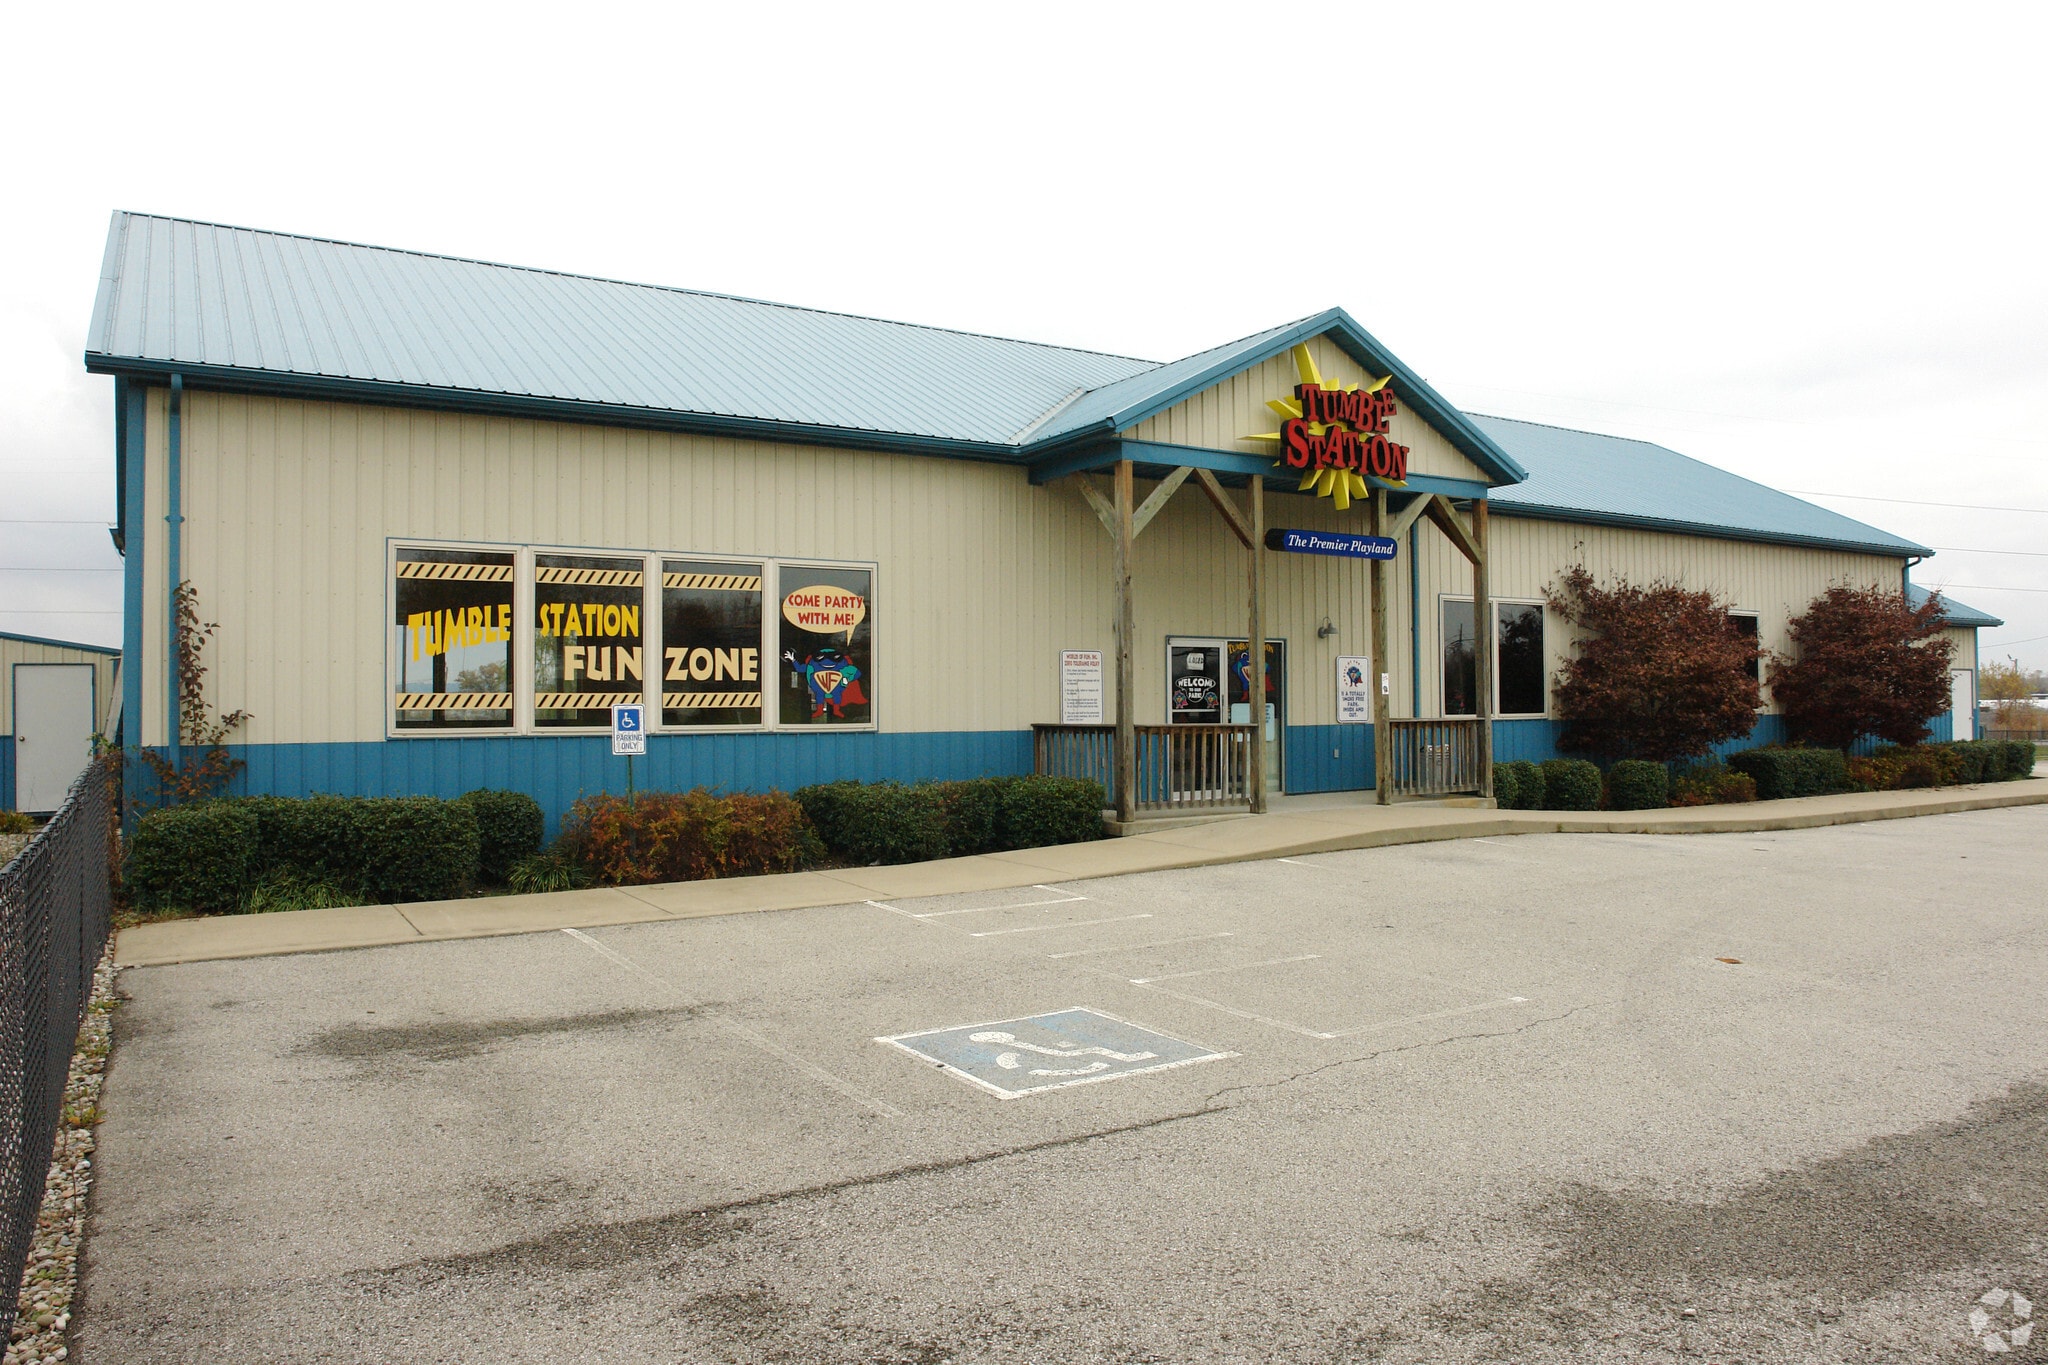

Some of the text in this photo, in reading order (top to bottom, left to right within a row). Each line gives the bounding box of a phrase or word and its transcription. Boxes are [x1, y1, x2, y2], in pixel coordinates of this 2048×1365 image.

[1299, 384, 1397, 434] TUMBLE
[1284, 418, 1409, 480] STATION
[1288, 534, 1394, 555] The Premier Playland
[788, 594, 863, 609] COME PARTY
[798, 612, 854, 625] WITH ME!
[407, 603, 639, 662] TUMBLE STATION
[563, 645, 758, 681] FUN ZONE
[1178, 678, 1213, 687] WELCOME
[621, 742, 637, 750] ONLY
